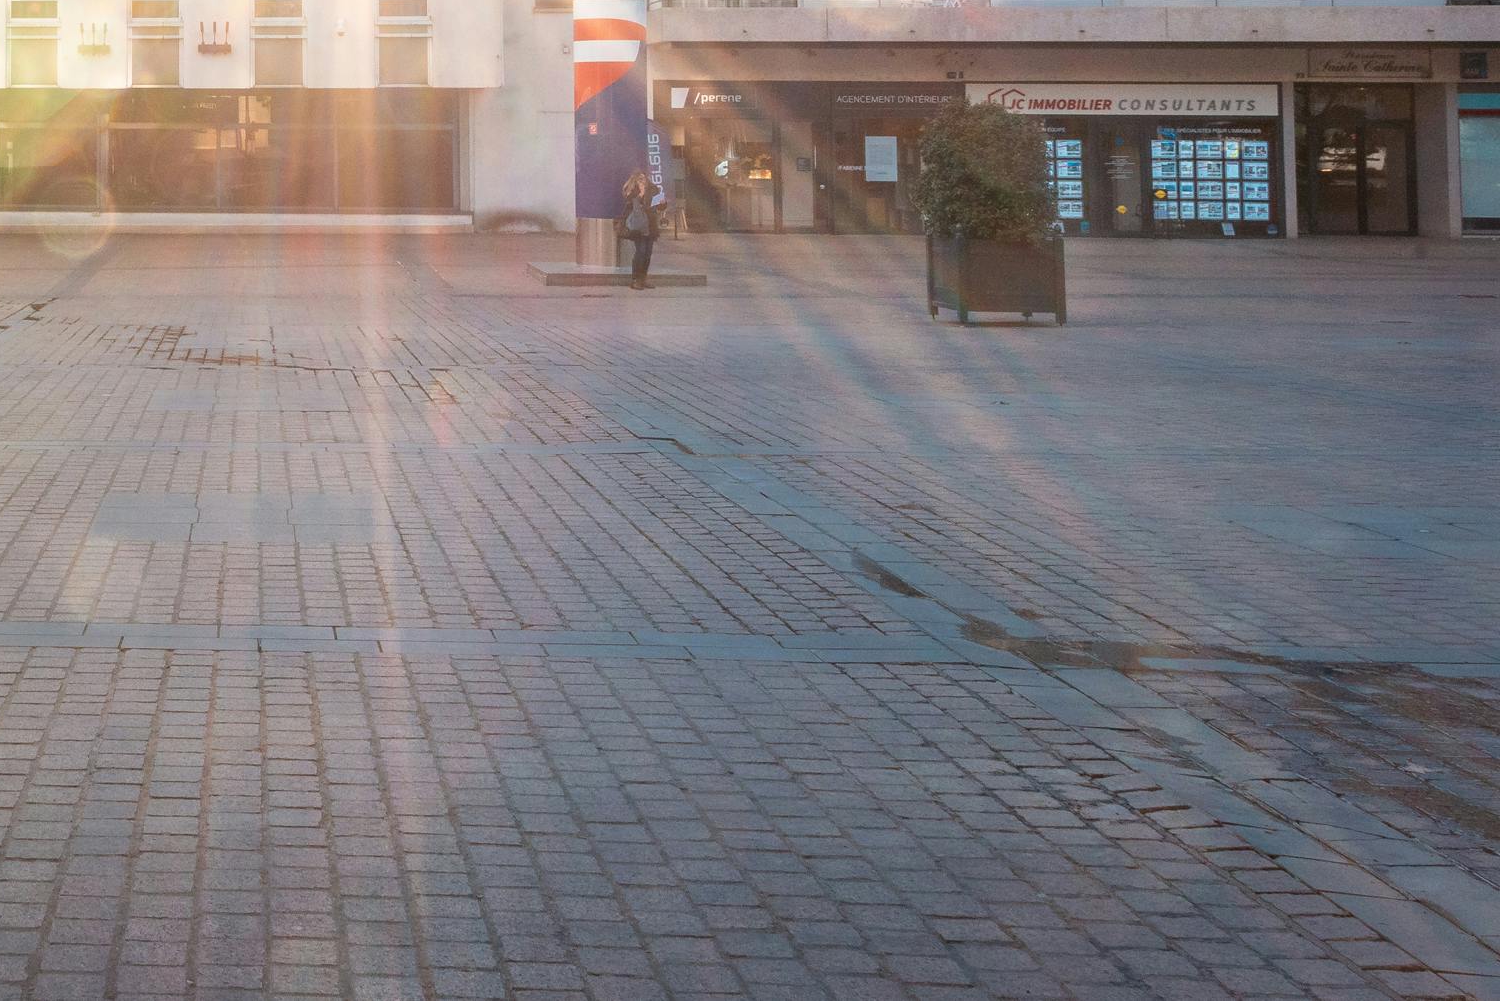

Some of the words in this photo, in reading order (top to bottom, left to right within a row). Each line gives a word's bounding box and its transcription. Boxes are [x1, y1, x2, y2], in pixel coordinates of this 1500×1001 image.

[1363, 59, 1423, 72] Catherine
[836, 95, 896, 104] AGENCEMENT
[1027, 99, 1112, 110] IMMOBILIER
[1118, 99, 1256, 111] CONSULTANTS
